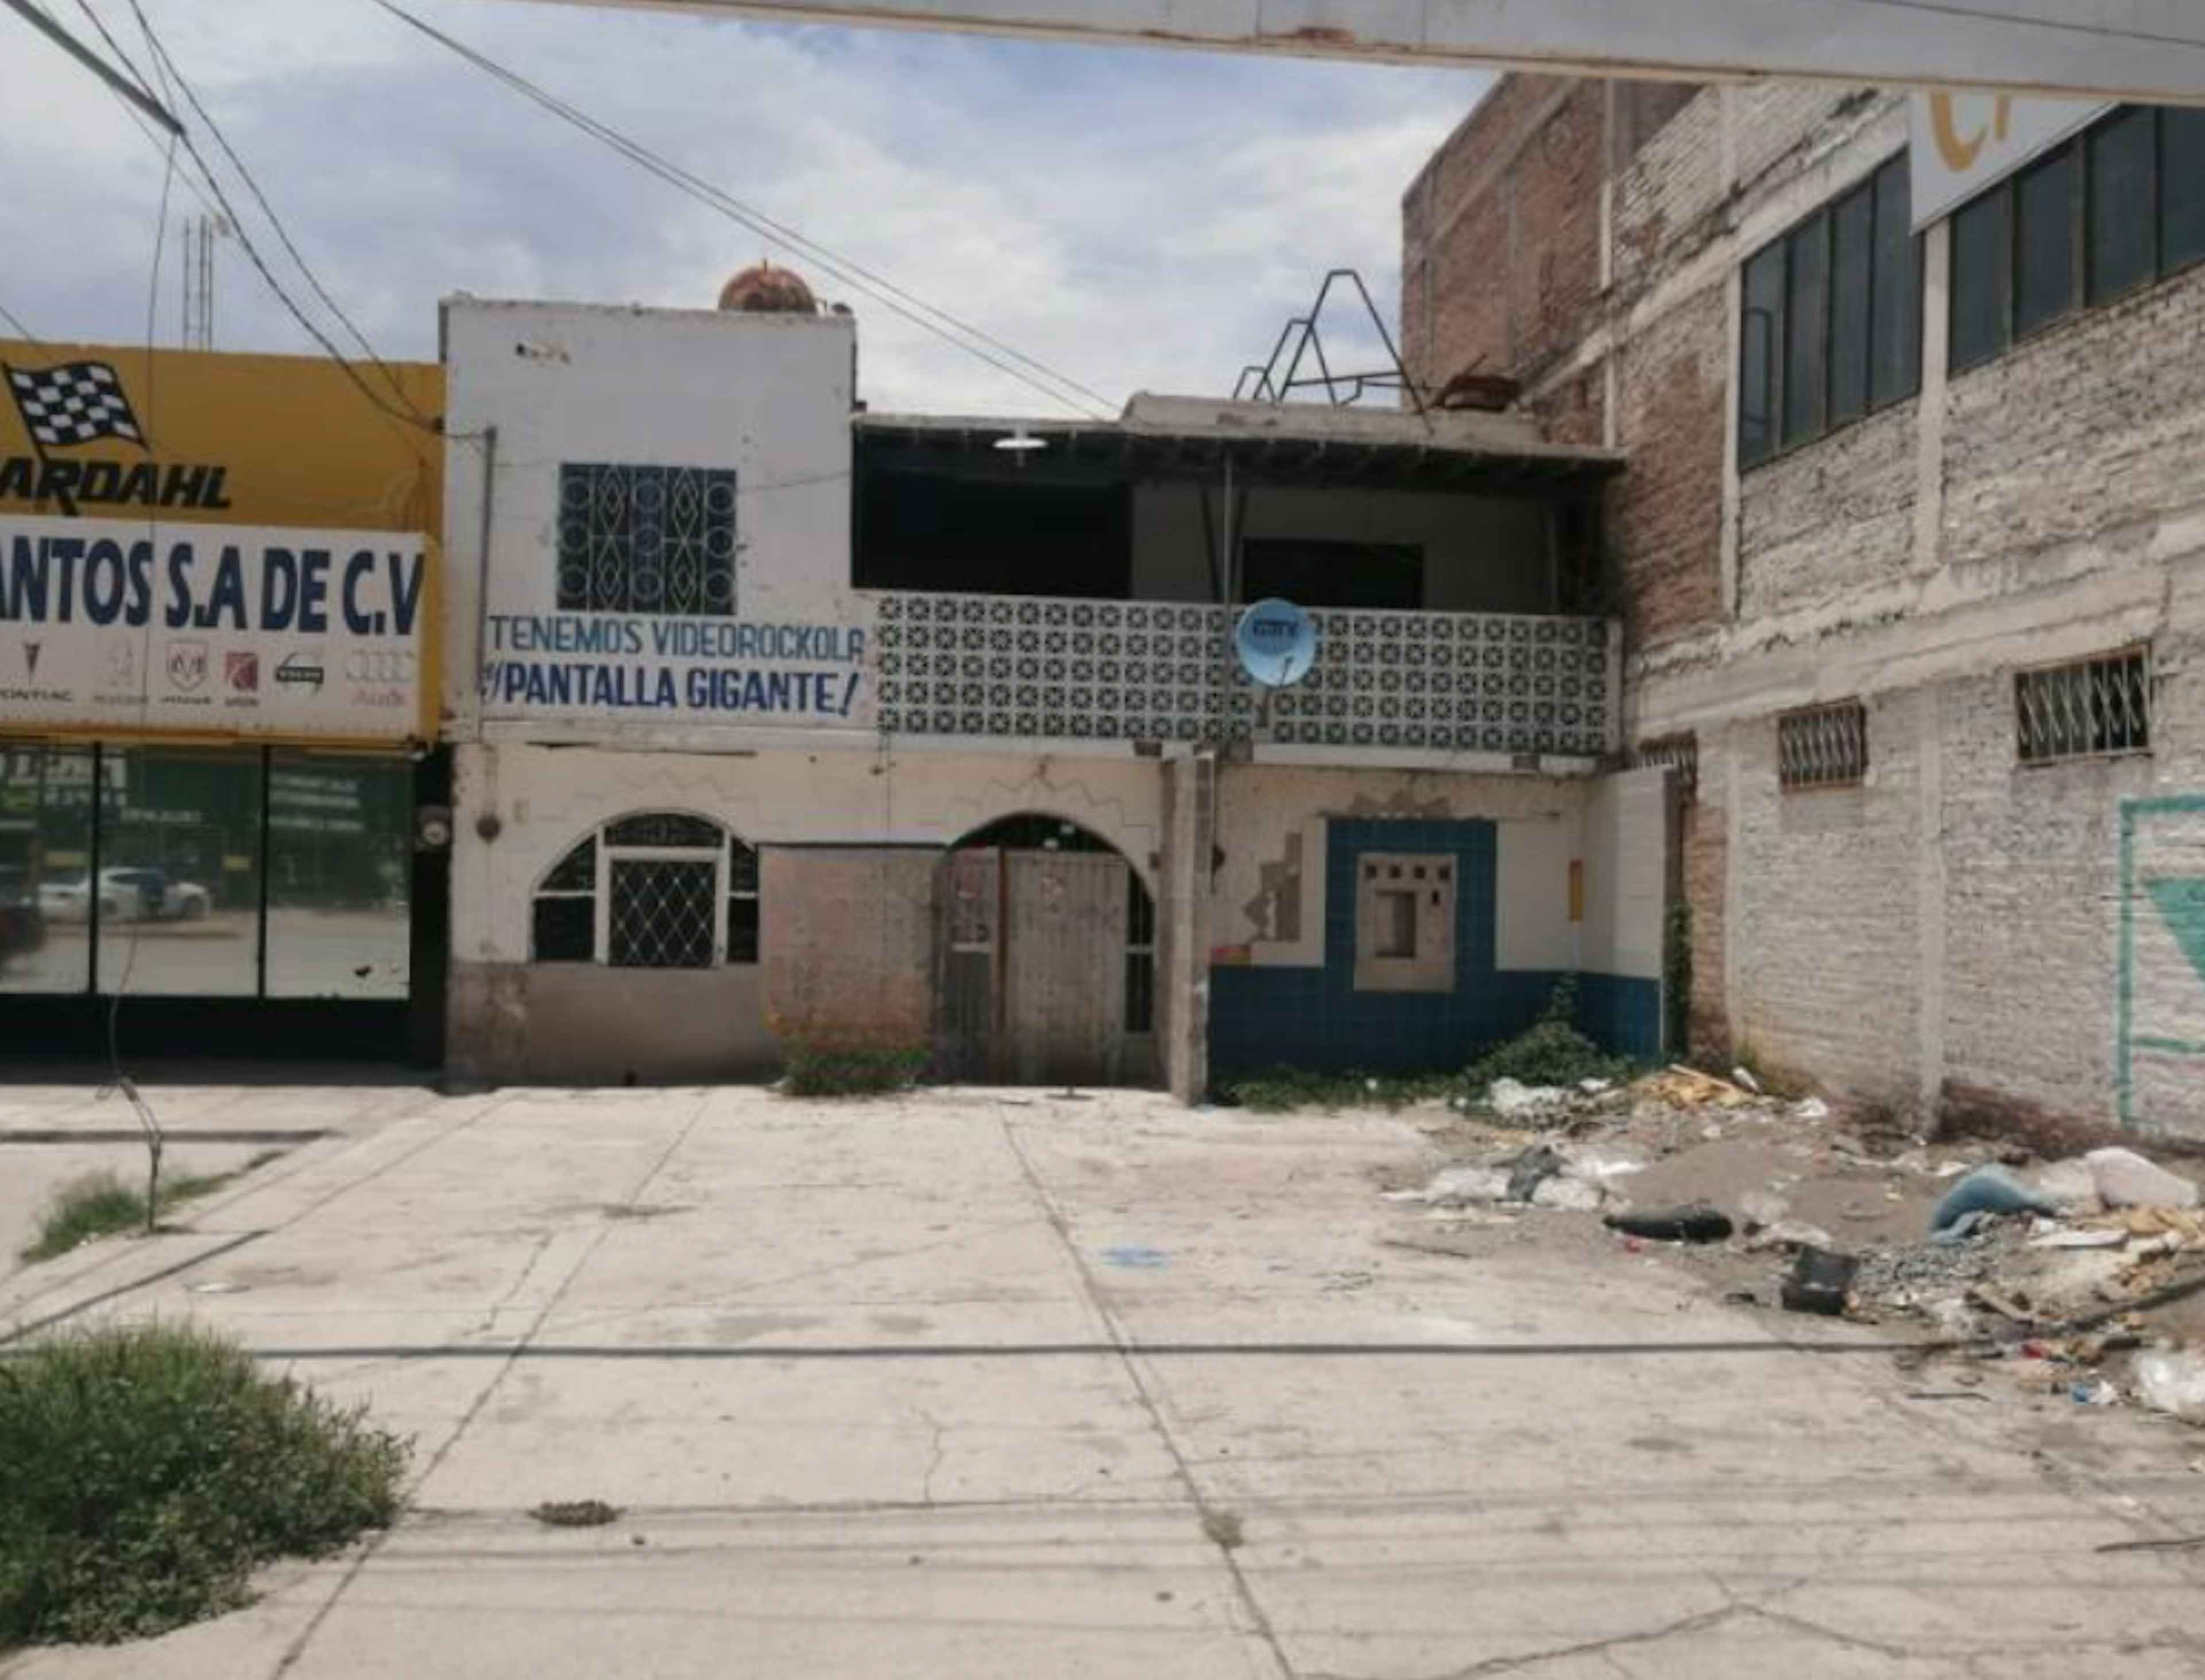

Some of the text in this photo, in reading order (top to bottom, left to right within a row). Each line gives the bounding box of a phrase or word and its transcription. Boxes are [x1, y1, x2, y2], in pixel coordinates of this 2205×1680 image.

[166, 542, 248, 630] S.A
[260, 547, 331, 633] DE
[342, 549, 426, 636] C.V
[488, 615, 644, 655] TENEMOS
[686, 666, 860, 718] GIGANTE!
